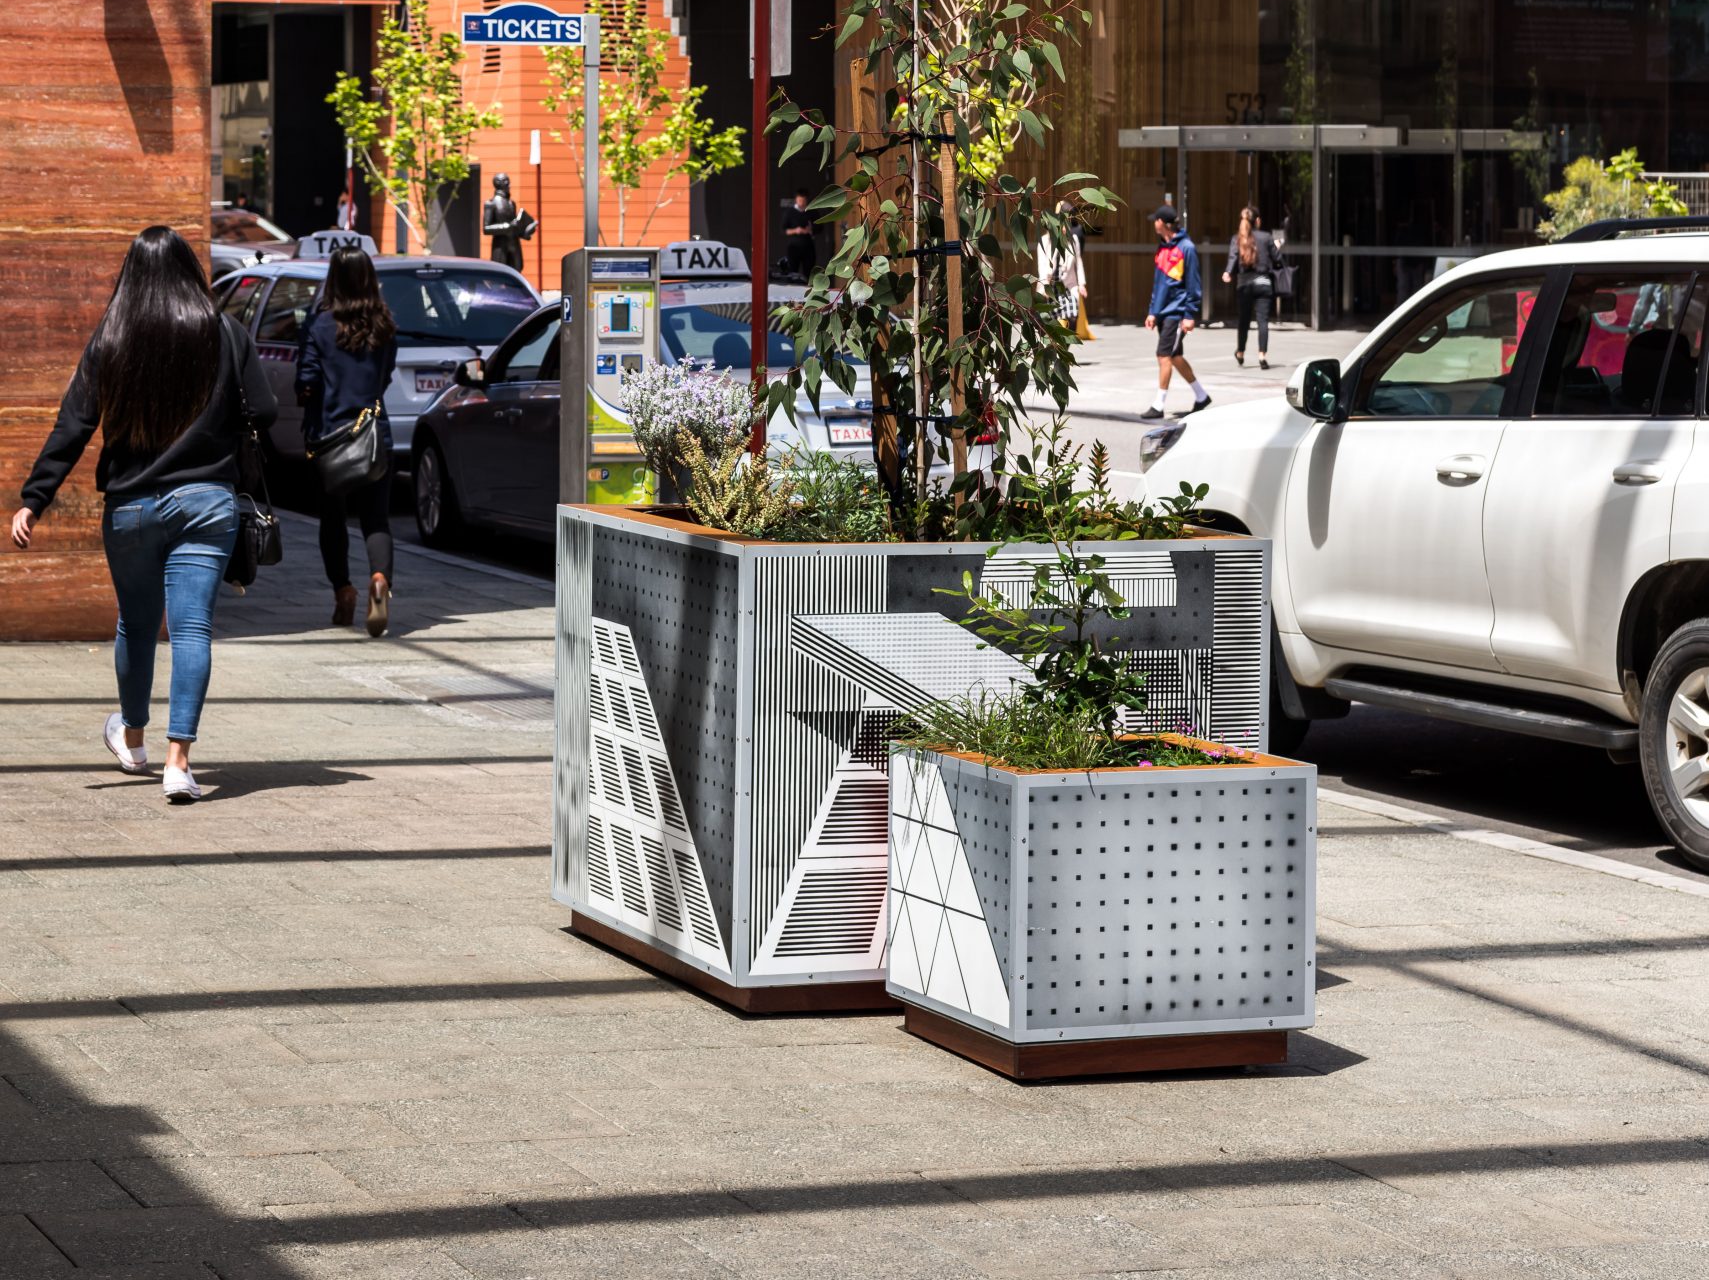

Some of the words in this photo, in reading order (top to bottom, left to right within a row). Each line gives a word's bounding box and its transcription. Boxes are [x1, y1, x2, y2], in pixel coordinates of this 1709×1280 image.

[483, 19, 580, 39] TICKETS
[1226, 93, 1266, 124] 573
[671, 247, 729, 269] TAXI
[563, 298, 570, 320] P
